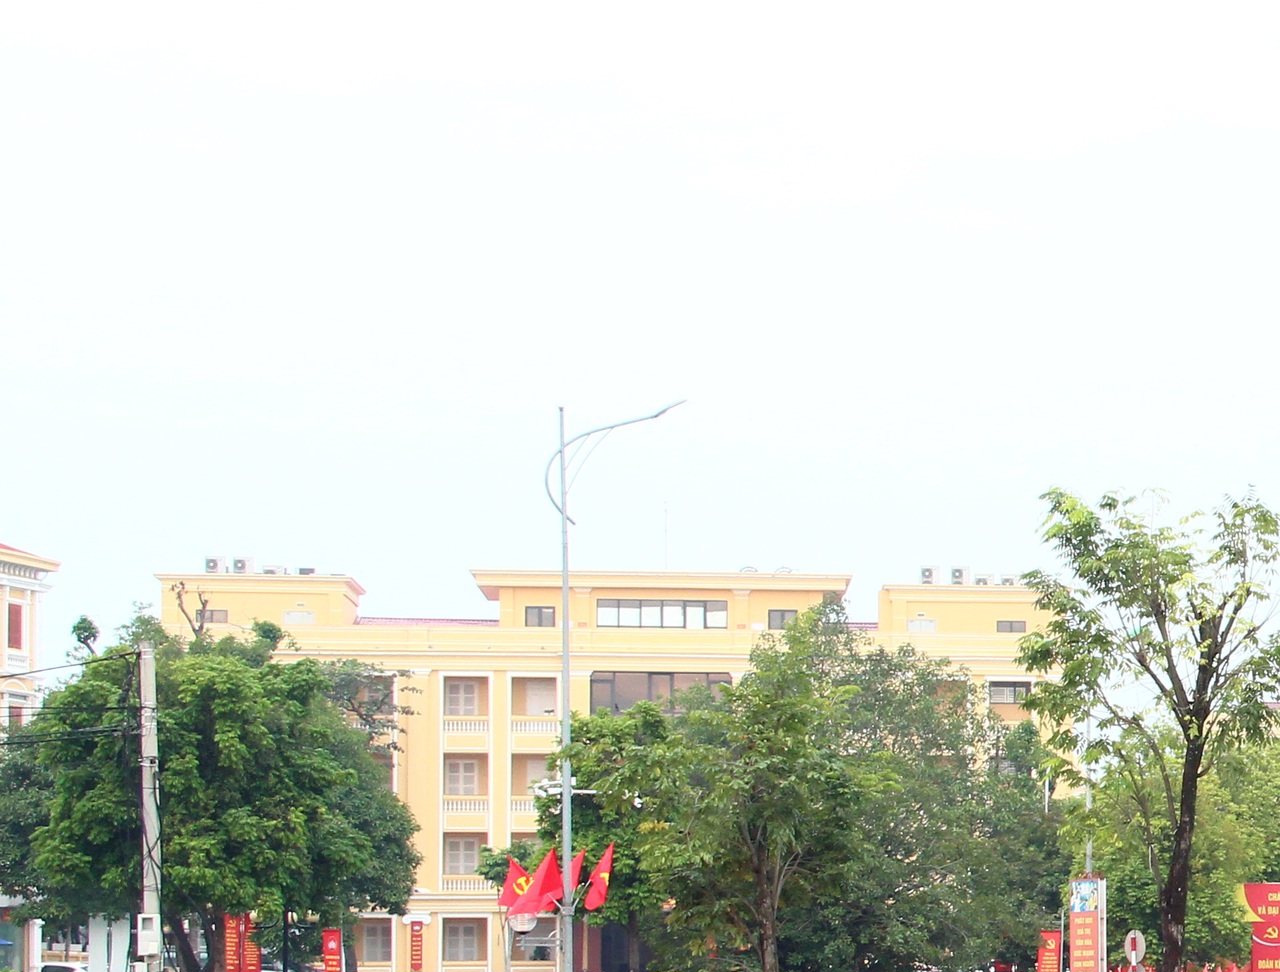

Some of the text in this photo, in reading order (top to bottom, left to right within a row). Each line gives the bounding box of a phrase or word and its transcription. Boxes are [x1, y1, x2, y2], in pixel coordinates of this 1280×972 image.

[1257, 905, 1267, 915] VÀ
[1267, 906, 1279, 916] ĐẠI
[1258, 958, 1274, 969] ĐOÀN
